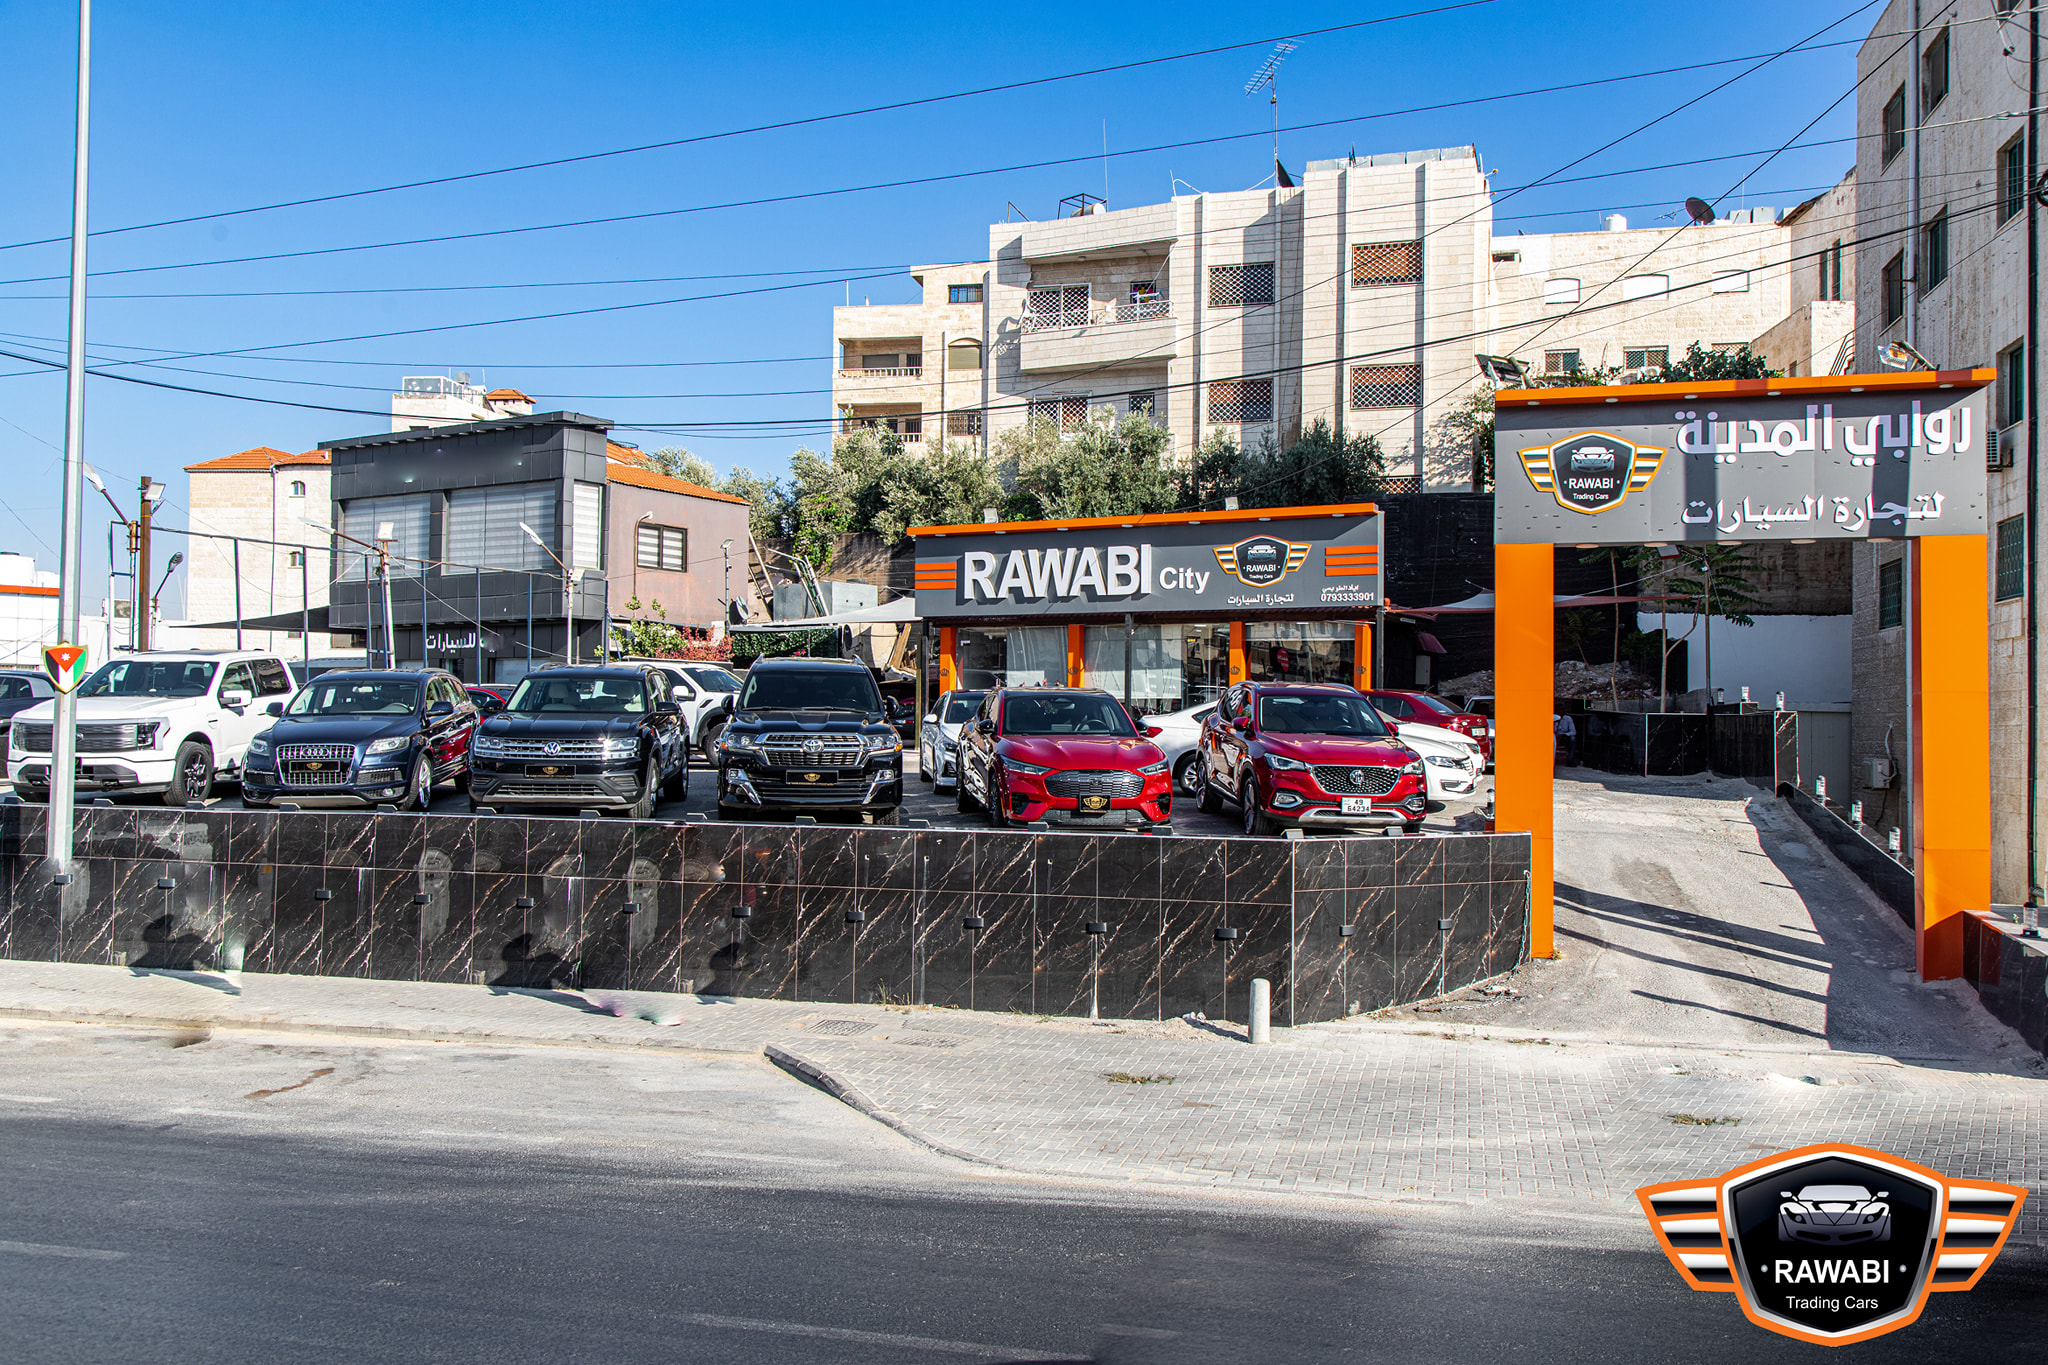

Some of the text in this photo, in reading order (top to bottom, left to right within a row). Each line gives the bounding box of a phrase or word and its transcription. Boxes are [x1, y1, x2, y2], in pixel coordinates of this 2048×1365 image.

[1674, 400, 1972, 467] روابي المدينة
[1568, 477, 1614, 489] RAWABI
[1573, 492, 1609, 501] Trading Cars
[1681, 490, 1946, 534] لتجارة السيارات
[964, 543, 1210, 600] RAWABI City
[1246, 564, 1276, 572] RAWABI
[1227, 593, 1295, 607] لتجارة السيارات
[1320, 592, 1375, 602] 0793333901
[425, 632, 477, 654] للسيارات
